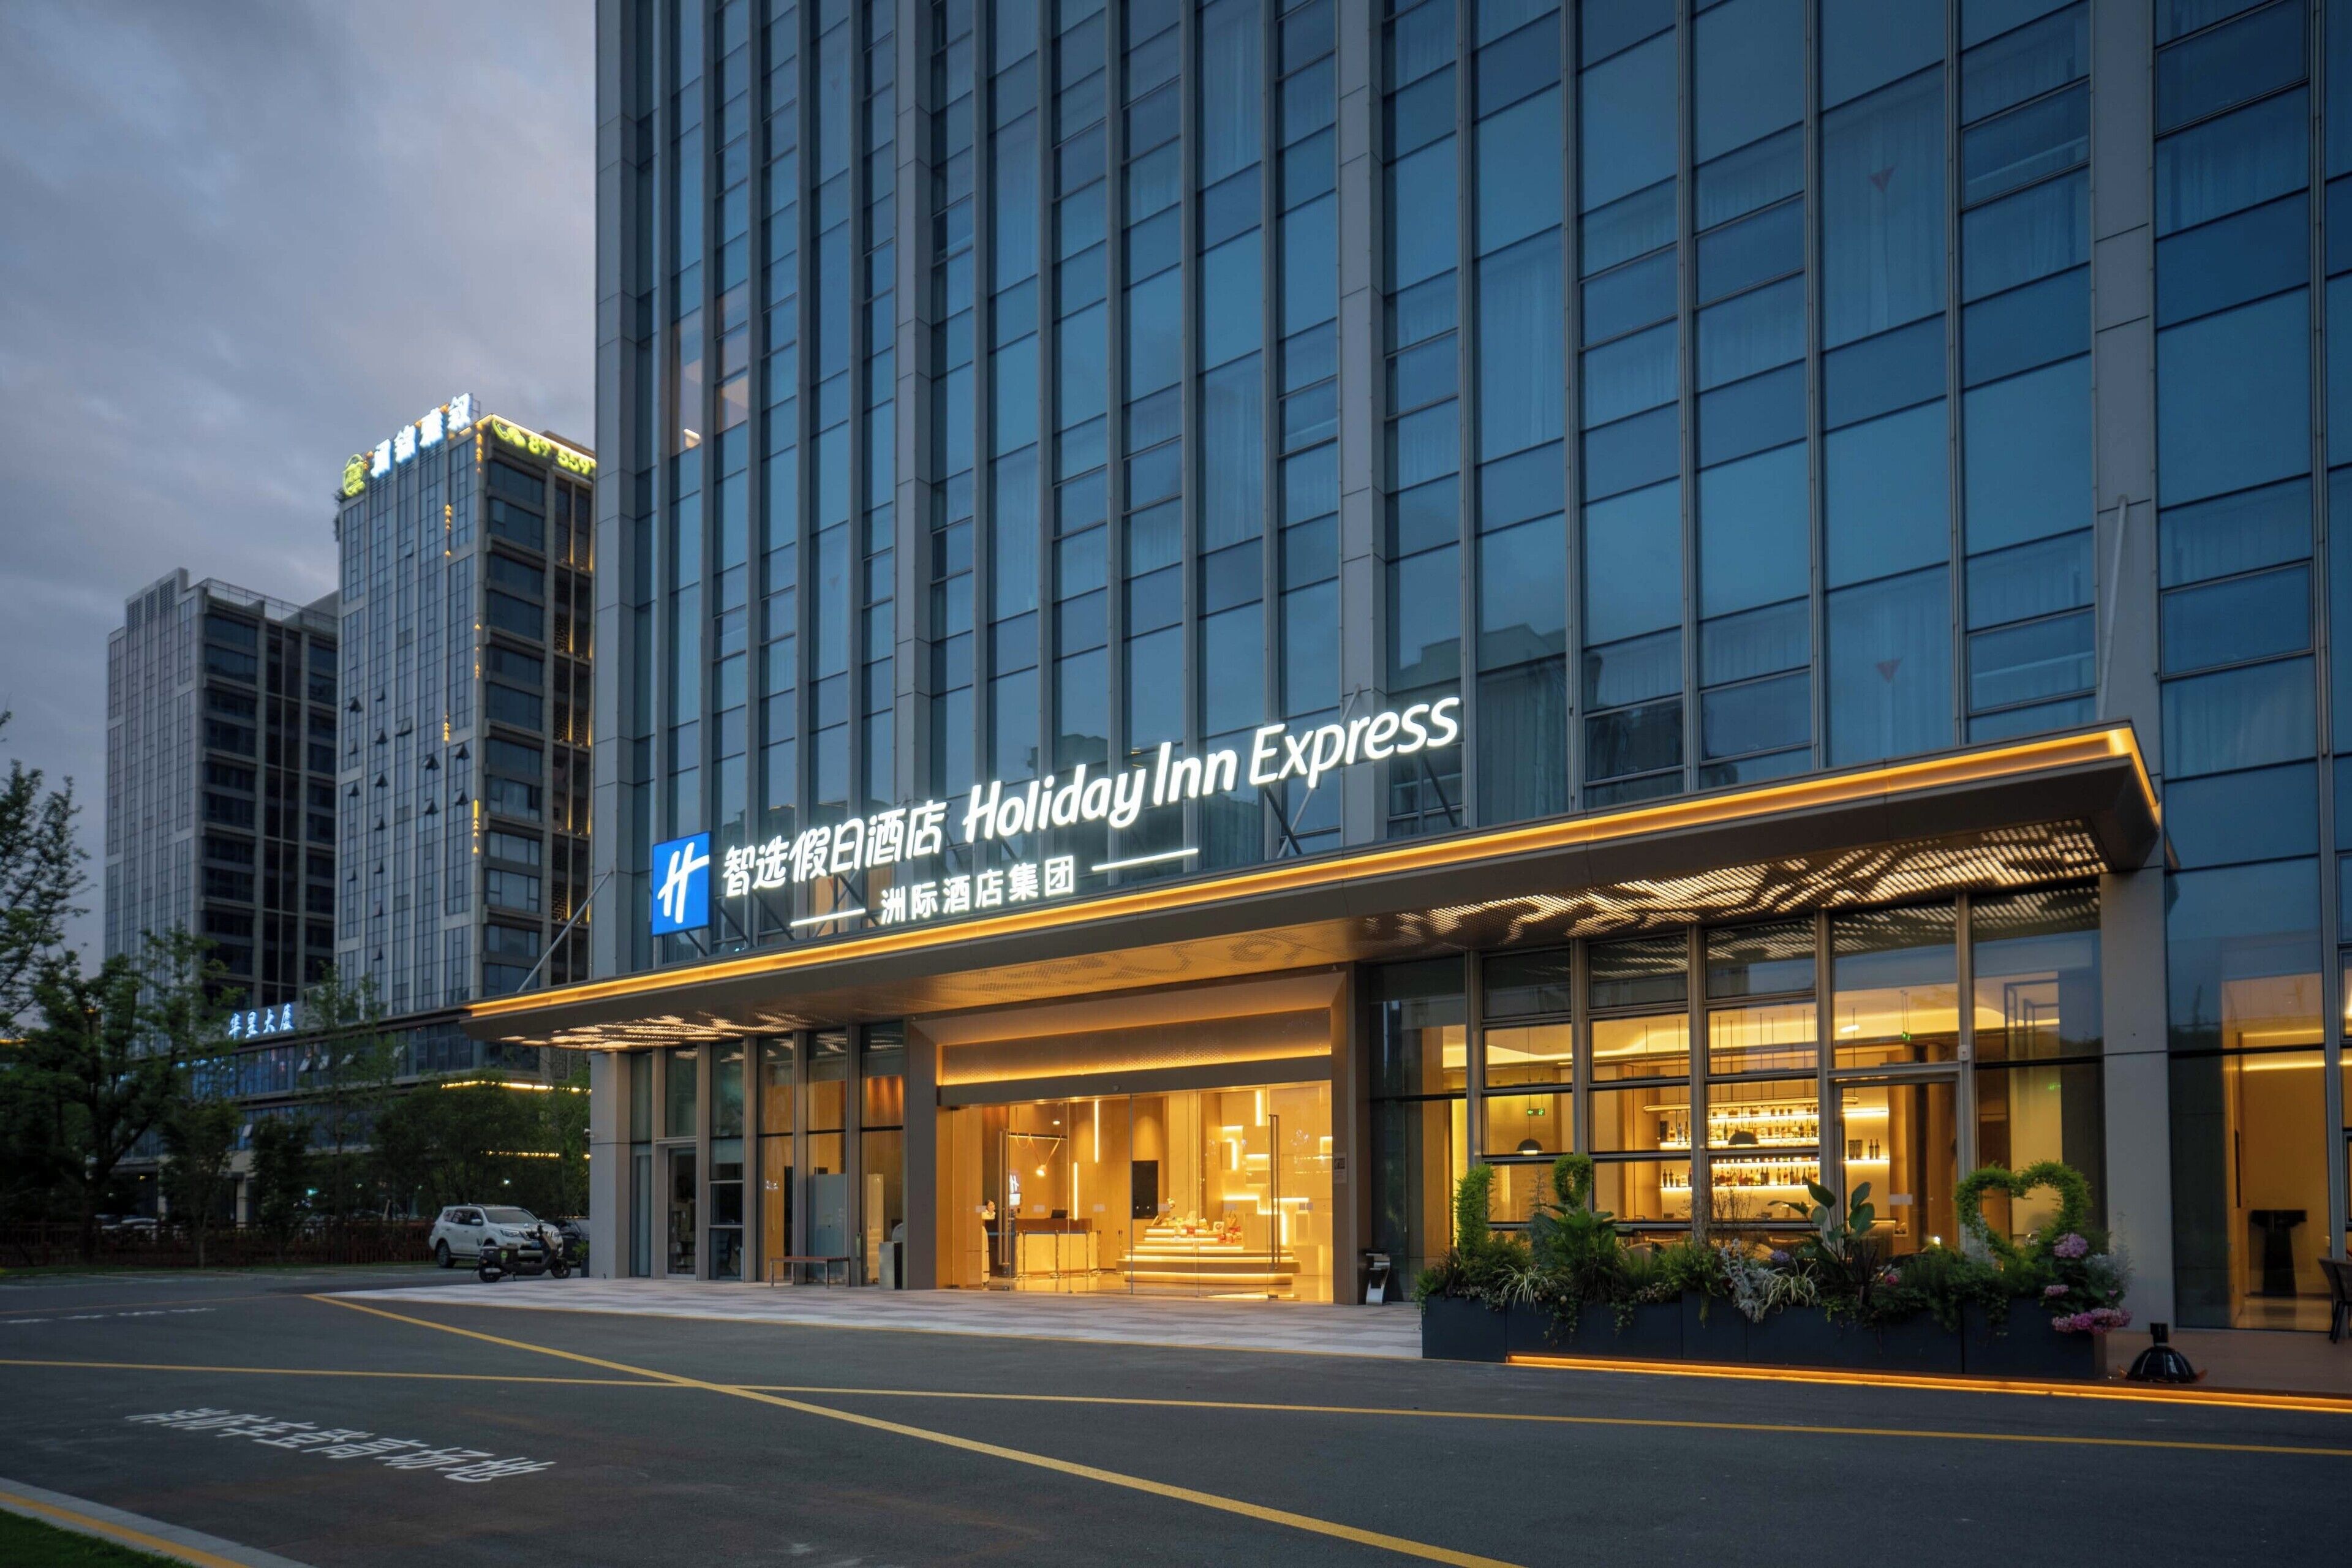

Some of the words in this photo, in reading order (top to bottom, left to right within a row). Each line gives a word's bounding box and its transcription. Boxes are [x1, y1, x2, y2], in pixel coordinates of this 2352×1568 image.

[963, 763, 1147, 843] Holiday
[1153, 741, 1238, 805] Inn
[1248, 696, 1461, 789] Express
[723, 799, 948, 897] 智选假日酒店
[880, 855, 1074, 924] 洲际酒店集团
